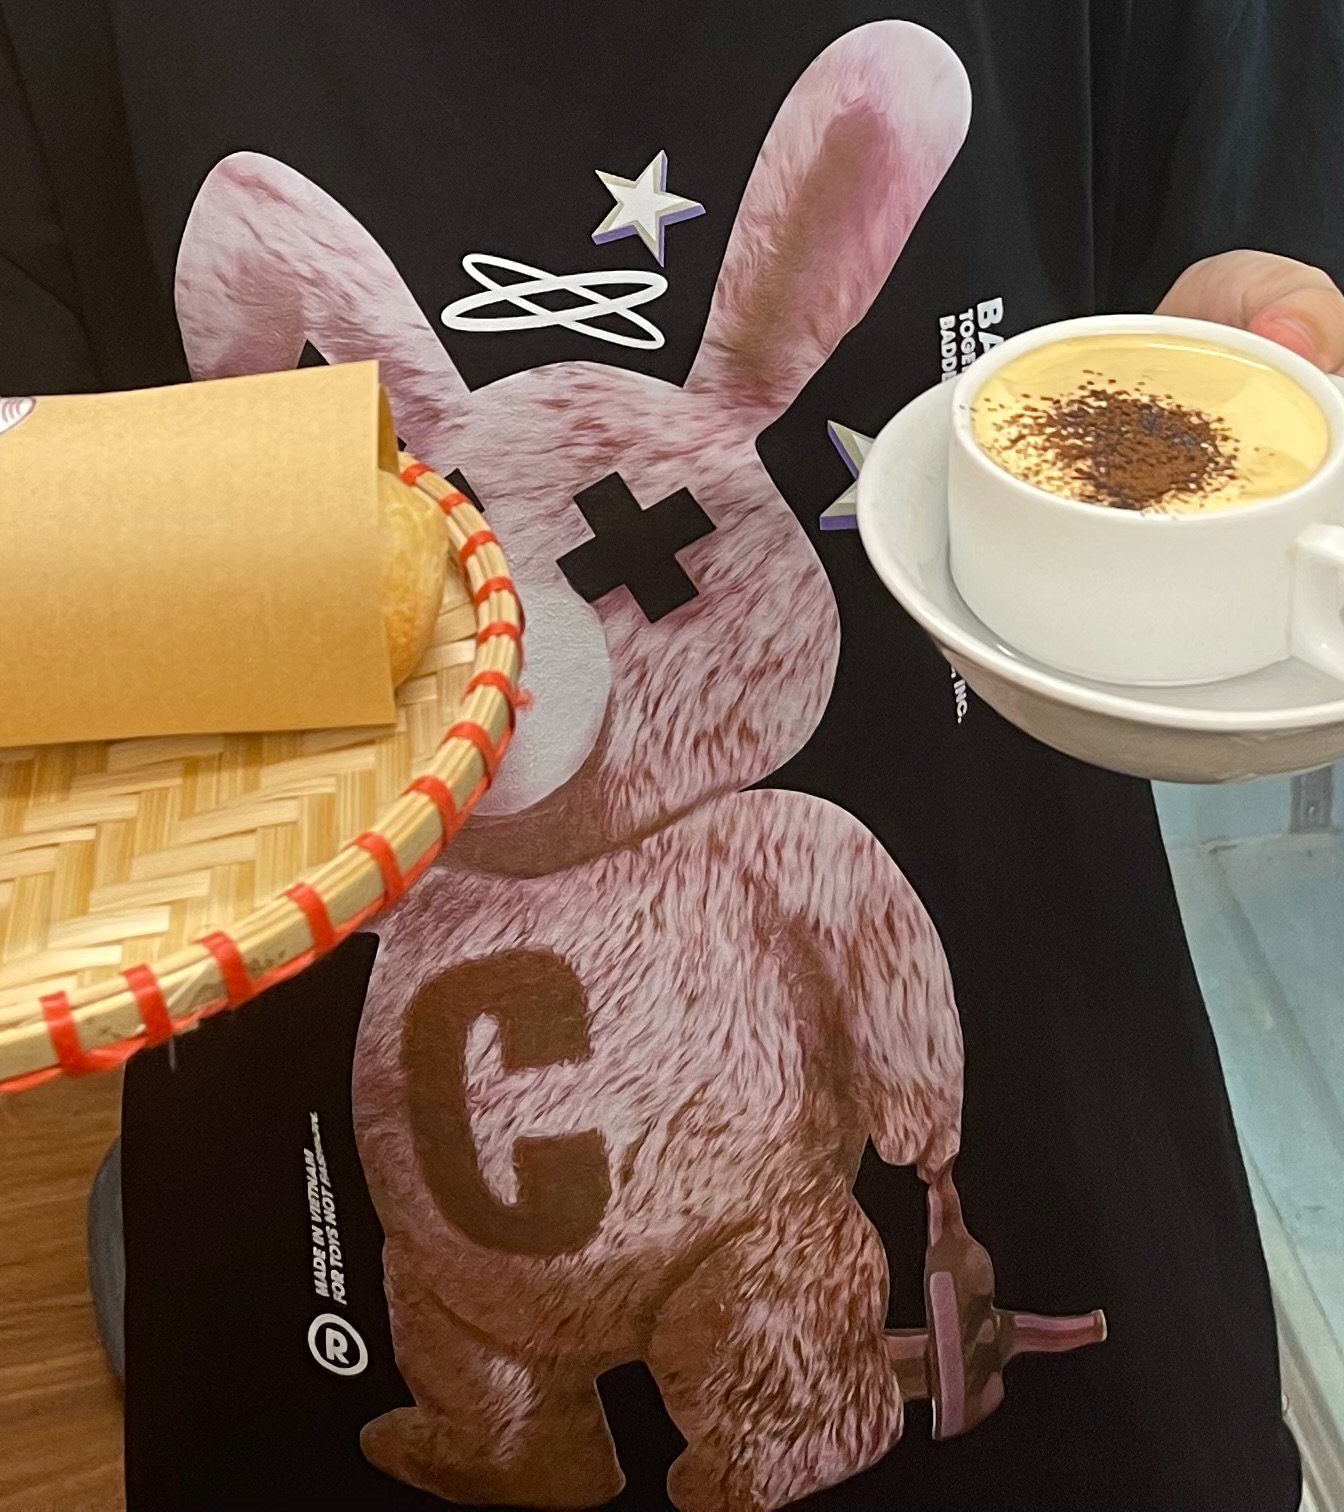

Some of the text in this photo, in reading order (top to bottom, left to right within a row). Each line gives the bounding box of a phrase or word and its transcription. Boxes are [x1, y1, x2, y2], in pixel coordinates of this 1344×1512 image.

[304, 1148, 322, 1222] VIETNAM
[311, 1224, 325, 1246] IN
[321, 1185, 348, 1305] FOR TOYS NOT
[313, 1246, 330, 1297] MADE
